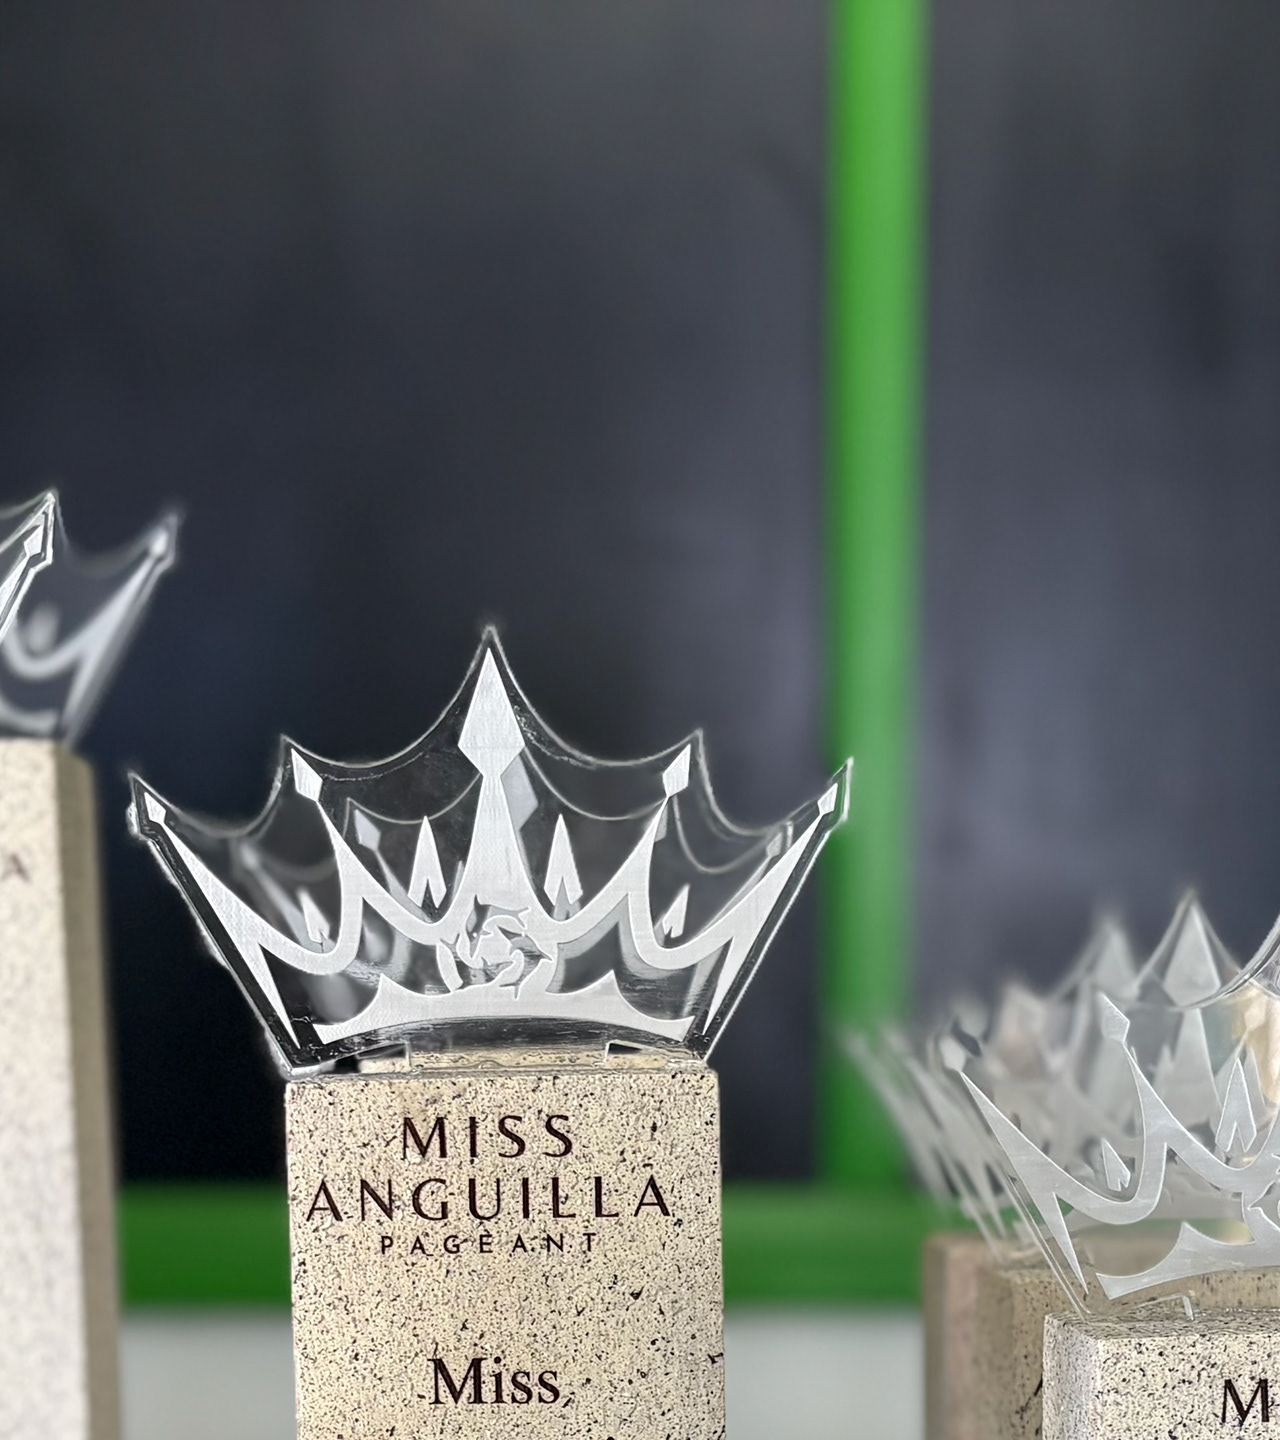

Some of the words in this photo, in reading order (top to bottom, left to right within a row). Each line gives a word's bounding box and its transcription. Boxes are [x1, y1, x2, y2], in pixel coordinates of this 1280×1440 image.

[402, 1115, 574, 1160] MISS
[307, 1174, 671, 1222] ANGUILLA
[380, 1232, 597, 1255] PAGEANT
[428, 1356, 561, 1405] Miss
